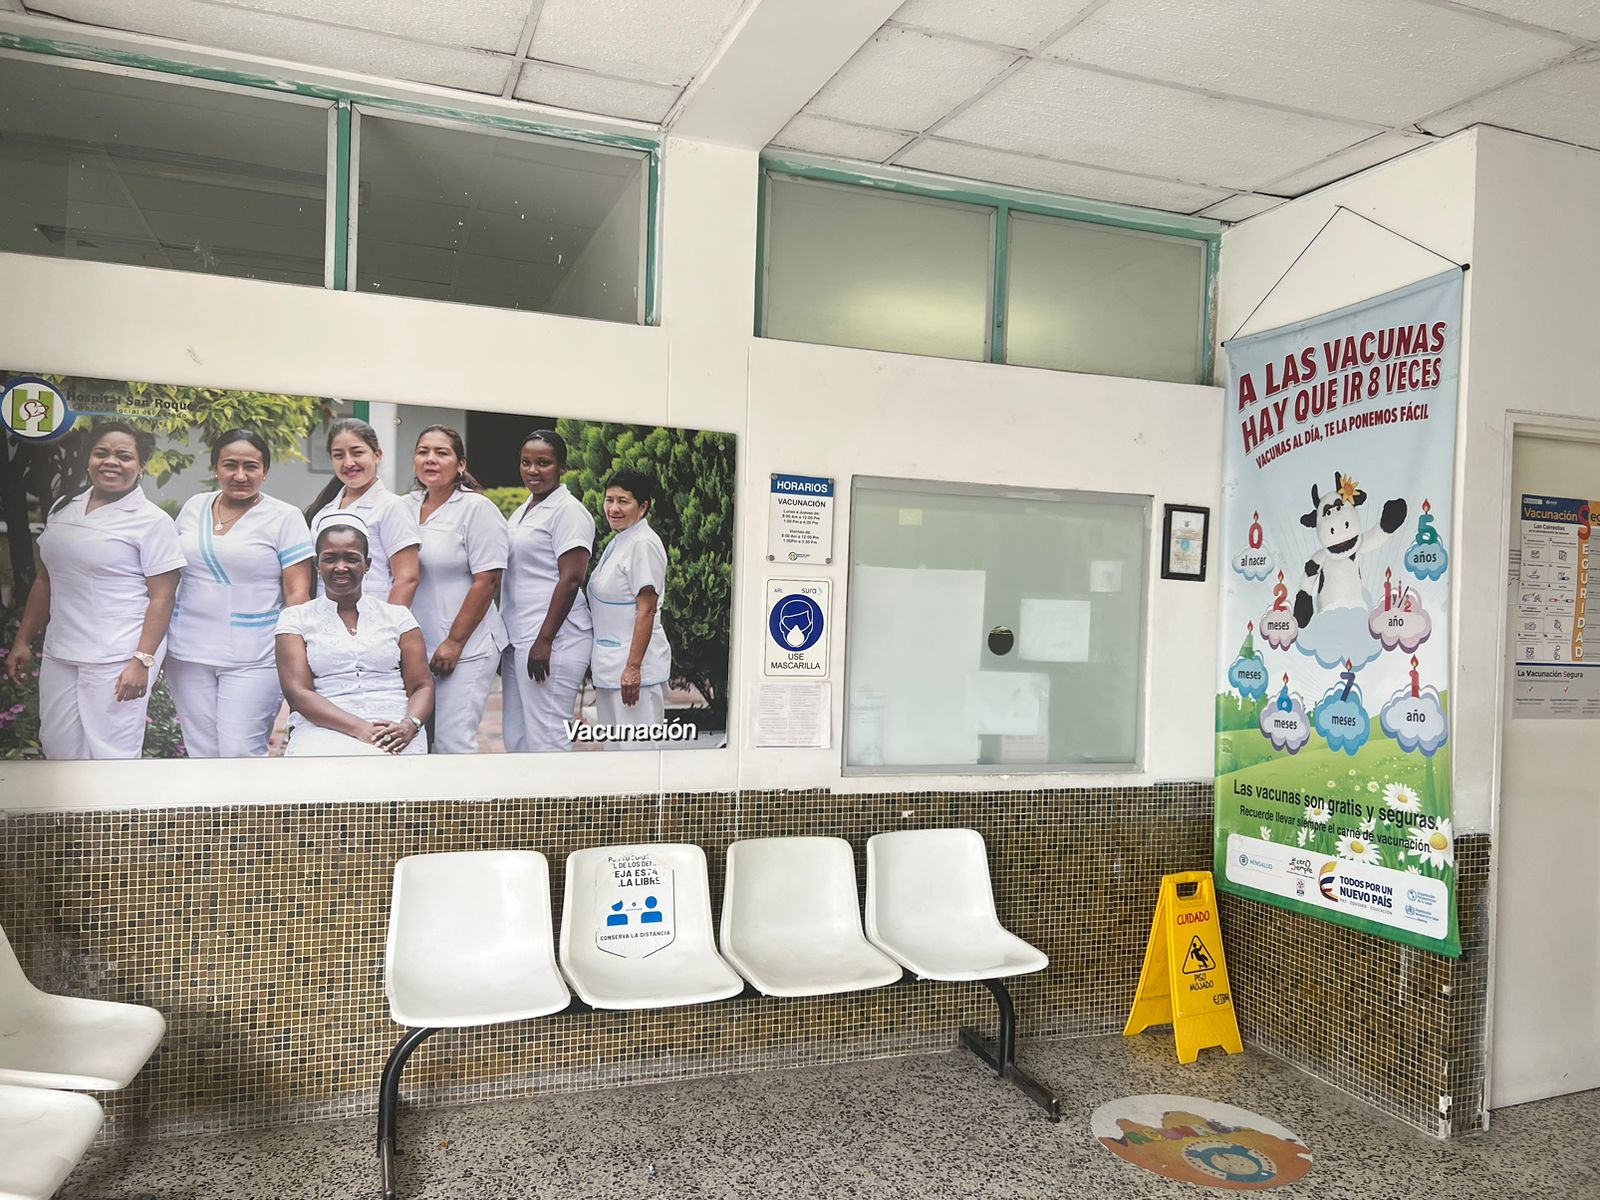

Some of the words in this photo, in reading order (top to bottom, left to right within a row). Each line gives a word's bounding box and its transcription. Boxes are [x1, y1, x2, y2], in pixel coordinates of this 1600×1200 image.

[1238, 373, 1258, 412] A
[1265, 346, 1317, 398] LAS
[1324, 321, 1447, 373] VACUNAS
[67, 391, 121, 406] Hospital
[126, 396, 150, 408] San
[155, 398, 194, 412] Roque
[1241, 398, 1288, 455] HAY
[1294, 378, 1338, 424] QUE
[1343, 371, 1364, 406] IR
[1368, 366, 1381, 399] 8
[1386, 357, 1441, 394] VECES
[1256, 438, 1291, 469] VACUNAS
[1293, 434, 1303, 450] AL
[1305, 425, 1323, 445] DÍA,
[1324, 423, 1334, 437] TE
[1336, 419, 1347, 434] LA
[1349, 408, 1397, 431] PONEMOS
[1401, 402, 1428, 422] FÁCIL
[777, 480, 828, 493] HORARIOS
[778, 498, 826, 508] VACUNACIÓN
[1524, 507, 1578, 521] Vacunación
[1249, 522, 1263, 549] 0
[1416, 514, 1438, 545] 5
[1241, 555, 1247, 566] al
[1249, 556, 1266, 566] nacer
[1413, 550, 1437, 564] años
[1272, 583, 1288, 612] 2
[1268, 622, 1290, 630] meses
[1388, 615, 1404, 626] año
[771, 662, 820, 670] MASCARILLA
[1238, 670, 1261, 679] meses
[1526, 669, 1562, 677] Vacunación
[1563, 671, 1584, 679] Segura
[1340, 672, 1356, 702] 7
[1409, 670, 1420, 698] 1
[1332, 715, 1356, 727] meses
[1406, 709, 1426, 723] año
[563, 717, 698, 742] Vacunación
[1274, 719, 1297, 729] meses
[1234, 779, 1252, 796] Las
[1256, 786, 1300, 805] vacunas
[1304, 794, 1324, 810] son
[1328, 798, 1362, 817] gratis
[1366, 805, 1374, 823] y
[1379, 807, 1438, 830] seguras.
[1240, 805, 1274, 821] Recuerde
[1276, 812, 1295, 825] llevar
[1297, 818, 1326, 833] siempre
[1328, 823, 1334, 833] el
[1337, 826, 1360, 839] carné
[1363, 830, 1374, 841] de
[635, 877, 661, 886] LIBRE
[1340, 876, 1364, 888] TODOS
[1365, 882, 1380, 892] POR
[1382, 886, 1392, 895] UN
[1340, 886, 1370, 902] NUEVO
[1372, 896, 1392, 908] PAÍS
[1177, 910, 1210, 925] CUIDADO
[600, 933, 629, 941] CONSERVA
[1194, 973, 1207, 982] PISO
[1190, 980, 1214, 992] MOJADO
